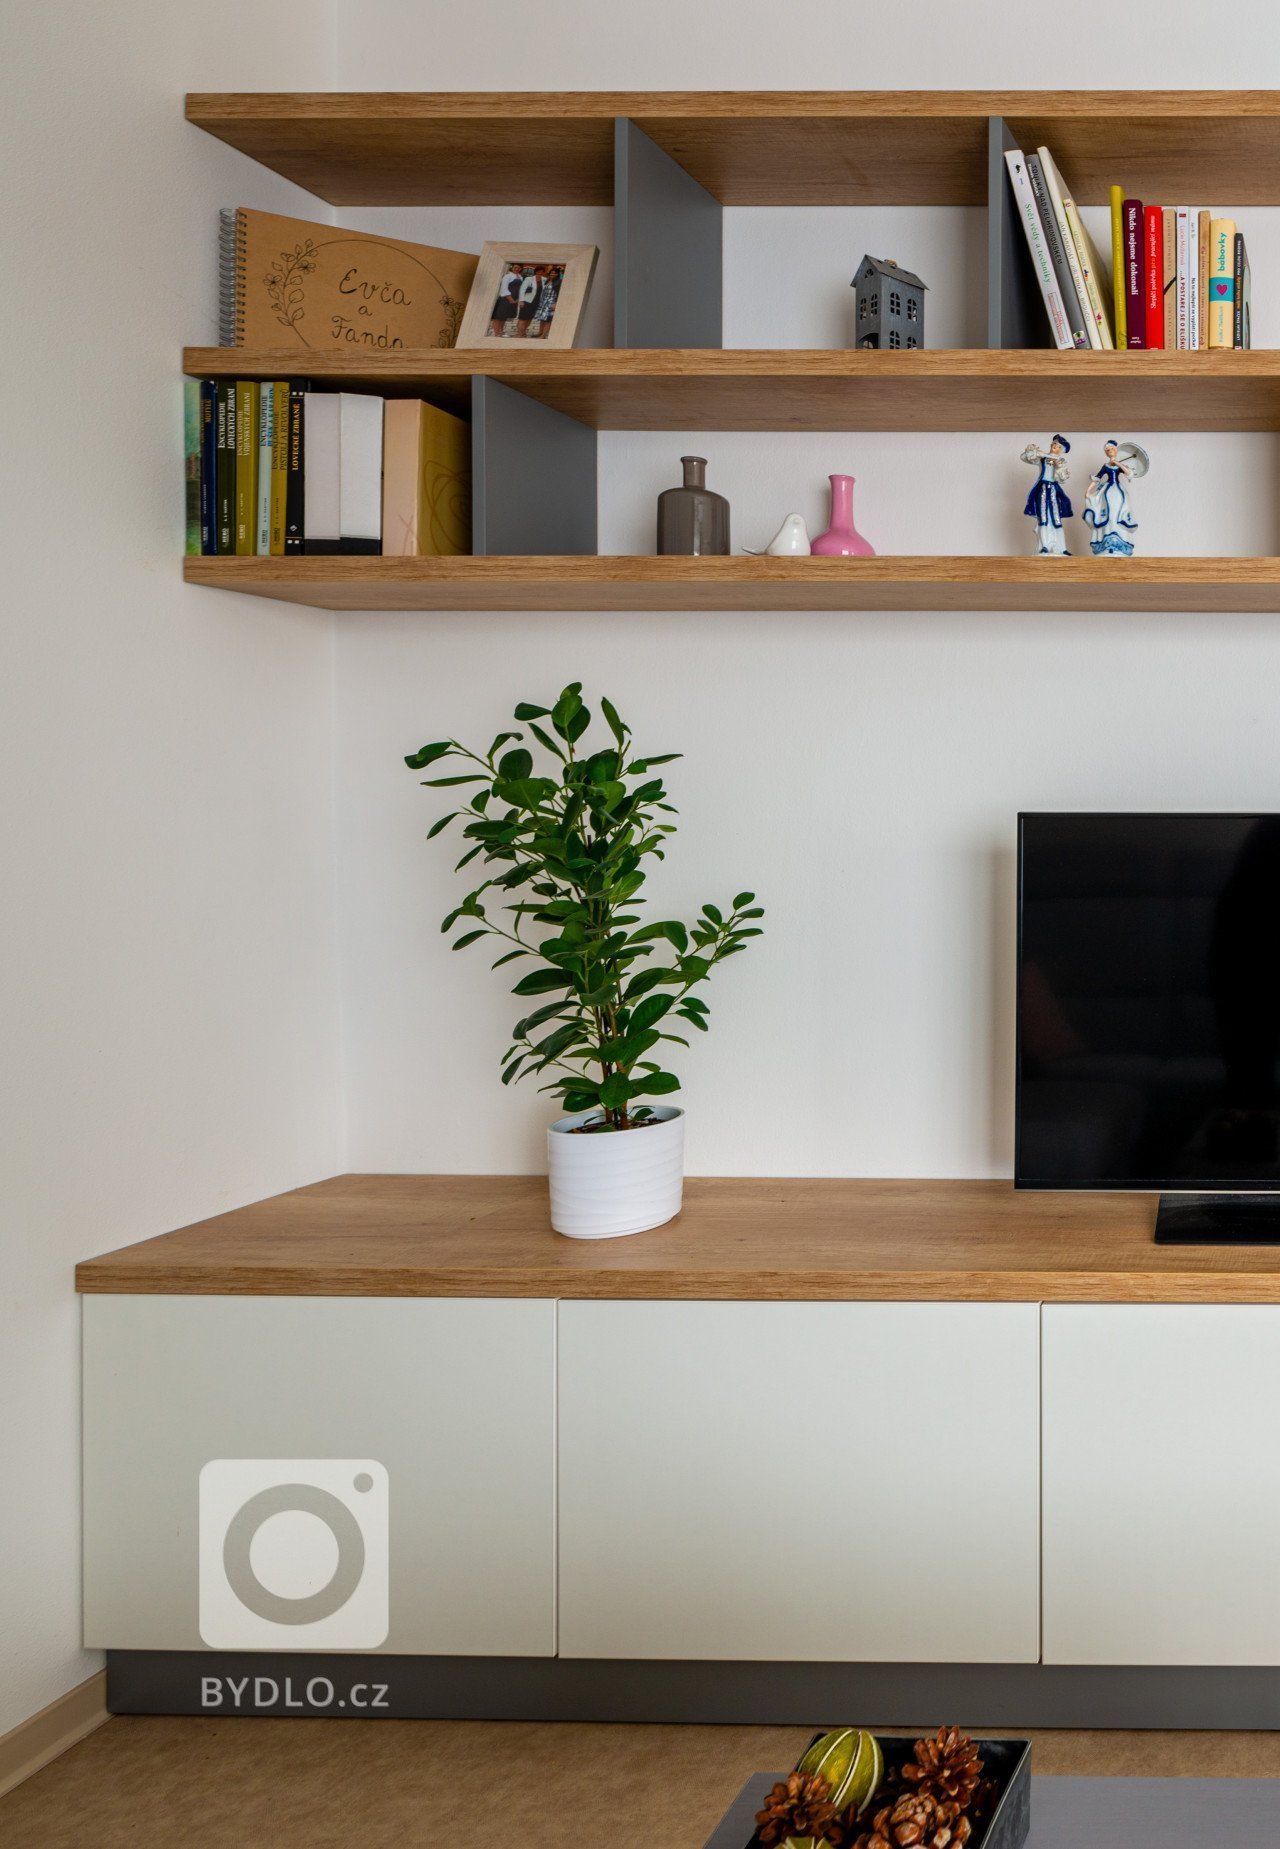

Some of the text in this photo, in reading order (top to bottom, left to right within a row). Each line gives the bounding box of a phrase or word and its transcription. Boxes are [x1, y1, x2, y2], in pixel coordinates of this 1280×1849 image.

[1025, 203, 1034, 220] Svět
[1038, 250, 1051, 283] techniky
[1129, 207, 1139, 295] Nikdo nejsme dokonalí
[1217, 232, 1227, 272] bábovky
[339, 268, 412, 306] Evča
[358, 305, 373, 317] a
[1180, 313, 1186, 321] SE
[217, 402, 226, 449] ENCYKLOPEDIE
[227, 388, 236, 449] LOVECKÝCH ZBRANÍ
